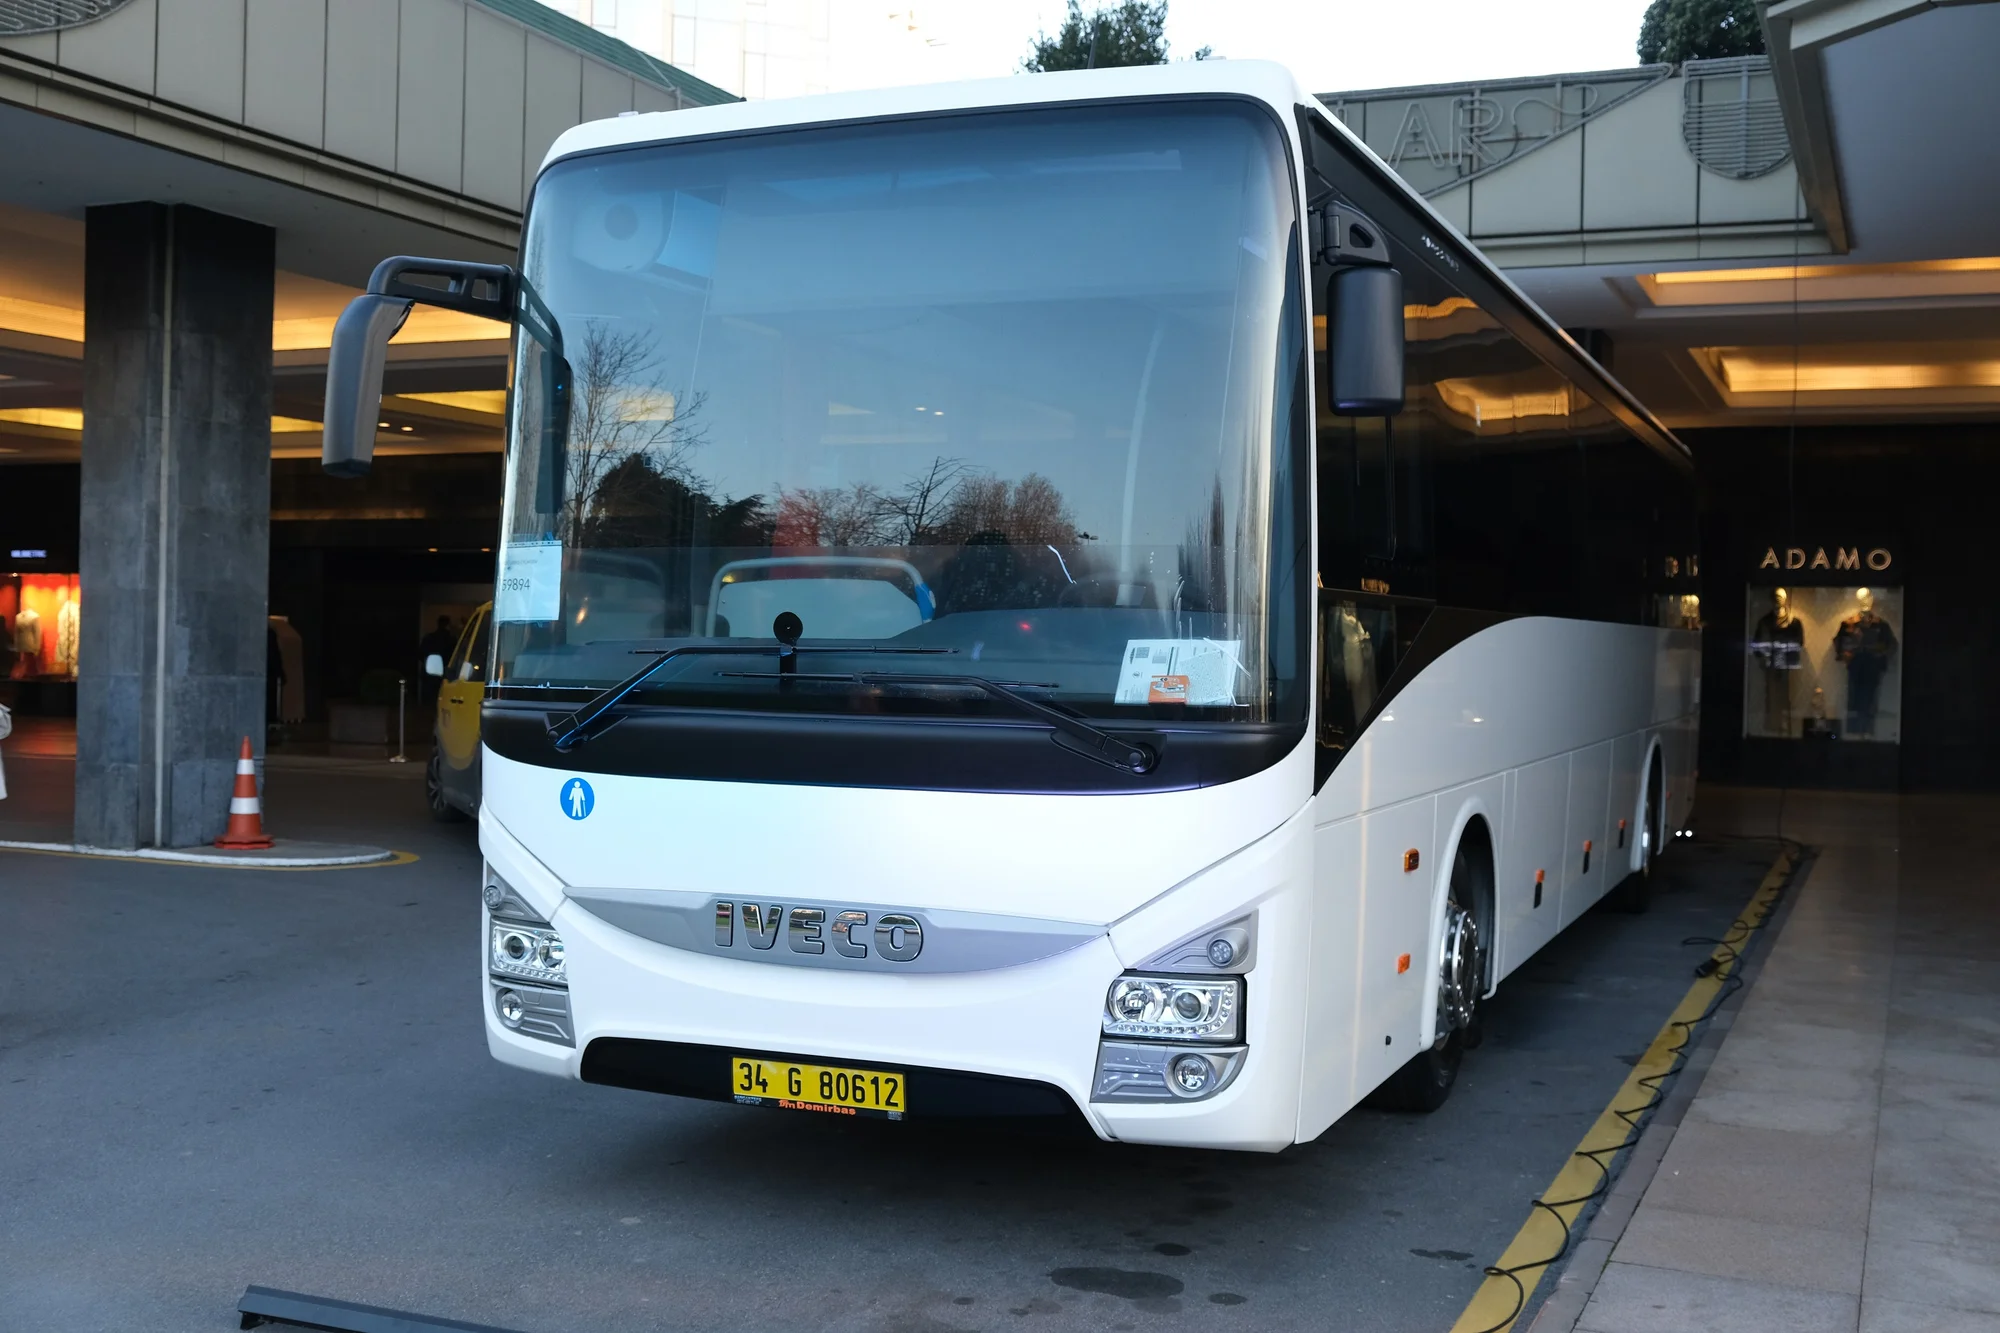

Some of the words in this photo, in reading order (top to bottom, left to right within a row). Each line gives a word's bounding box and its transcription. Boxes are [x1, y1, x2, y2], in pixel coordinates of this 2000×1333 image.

[1760, 547, 1892, 571] ADAMO
[714, 901, 924, 962] IVECO
[739, 1062, 768, 1093] 34
[788, 1067, 802, 1097] G
[819, 1071, 899, 1108] 80612
